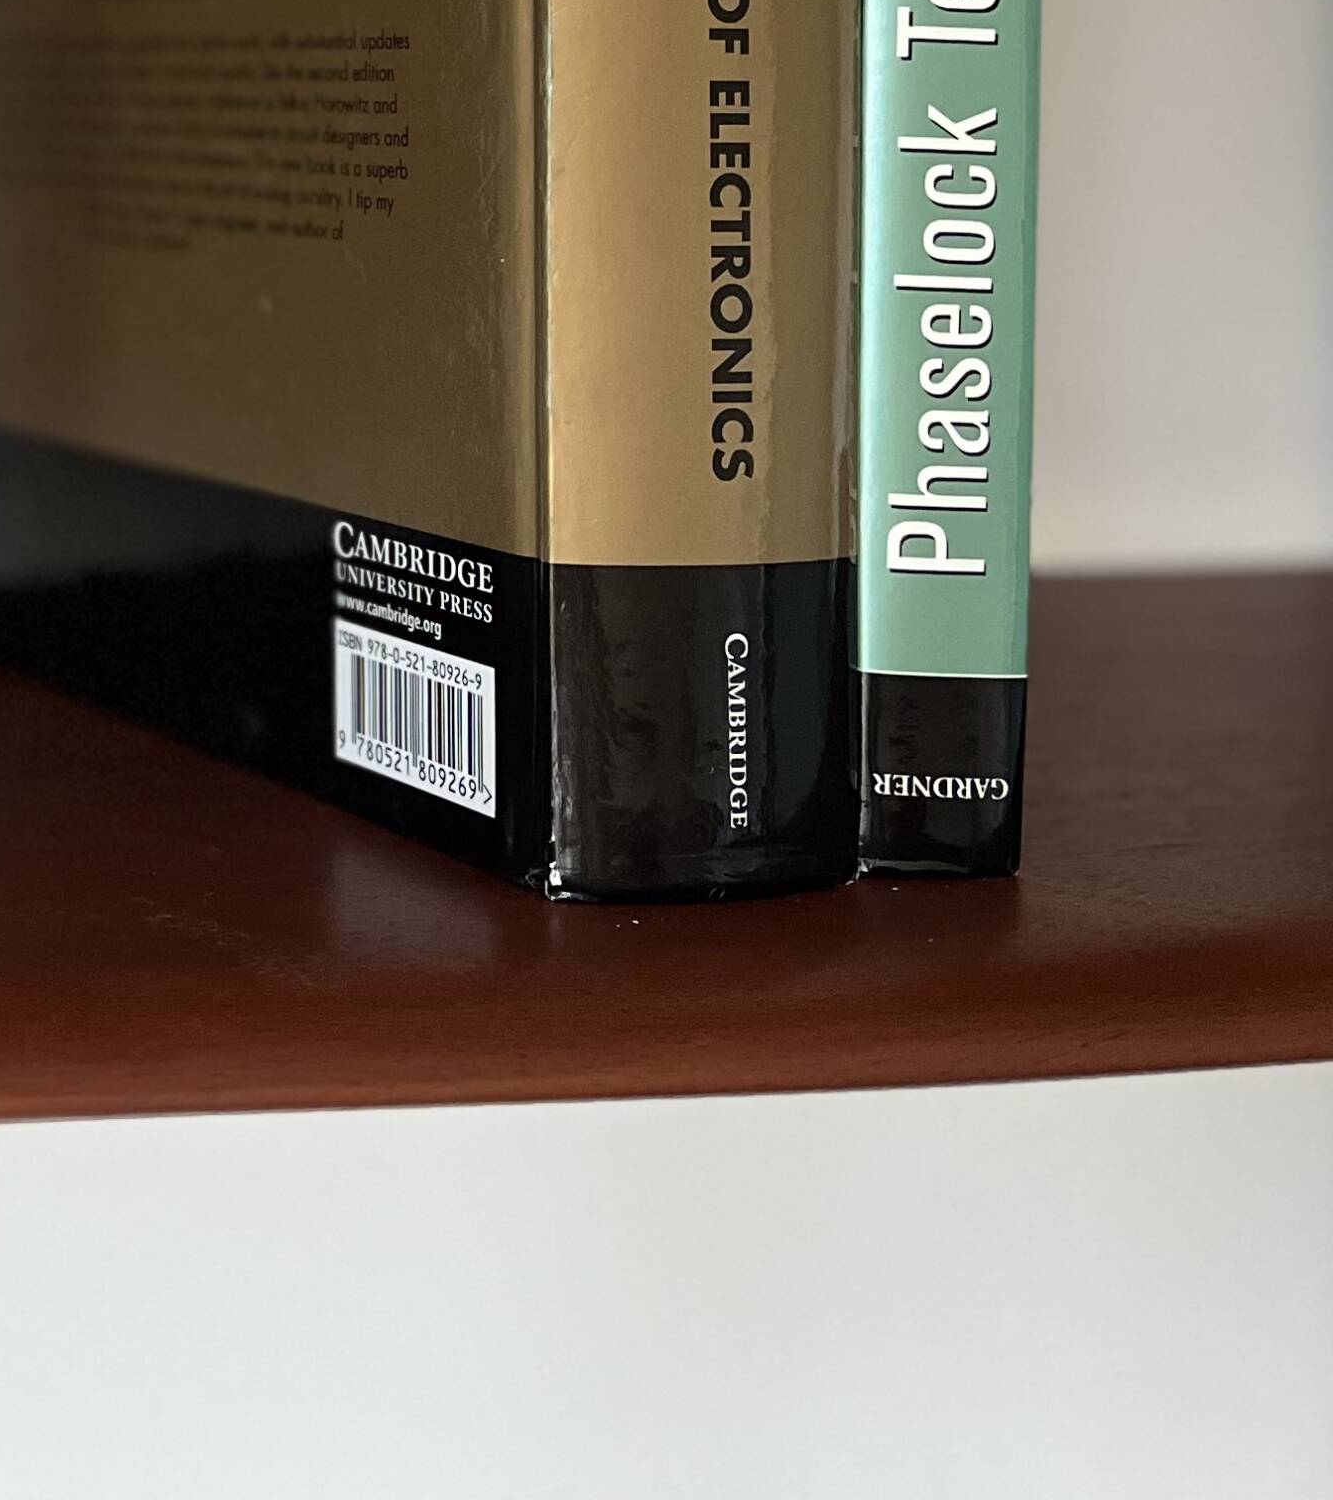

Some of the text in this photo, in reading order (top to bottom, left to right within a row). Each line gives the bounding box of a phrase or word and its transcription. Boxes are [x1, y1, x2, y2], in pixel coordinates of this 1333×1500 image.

[360, 28, 410, 54] updates
[352, 60, 395, 82] edition
[373, 93, 398, 114] and
[384, 125, 410, 147] and
[353, 164, 362, 177] a
[366, 158, 409, 184] superb
[356, 190, 373, 215] tip
[375, 195, 395, 218] my
[331, 219, 345, 241] of
[709, 80, 754, 482] ELECTRONICS
[886, 104, 998, 575] Phaselock
[334, 521, 494, 593] CAMBRIDGE
[336, 561, 493, 623] UNIVERSITY PRESS
[336, 593, 442, 640] www.cambridge.org
[339, 630, 482, 690] ISBN 978-0-521-80926-9
[724, 632, 749, 829] CAMBRIDGE
[339, 729, 477, 799] 9 780521 809269
[871, 772, 1010, 801] GARDNER
